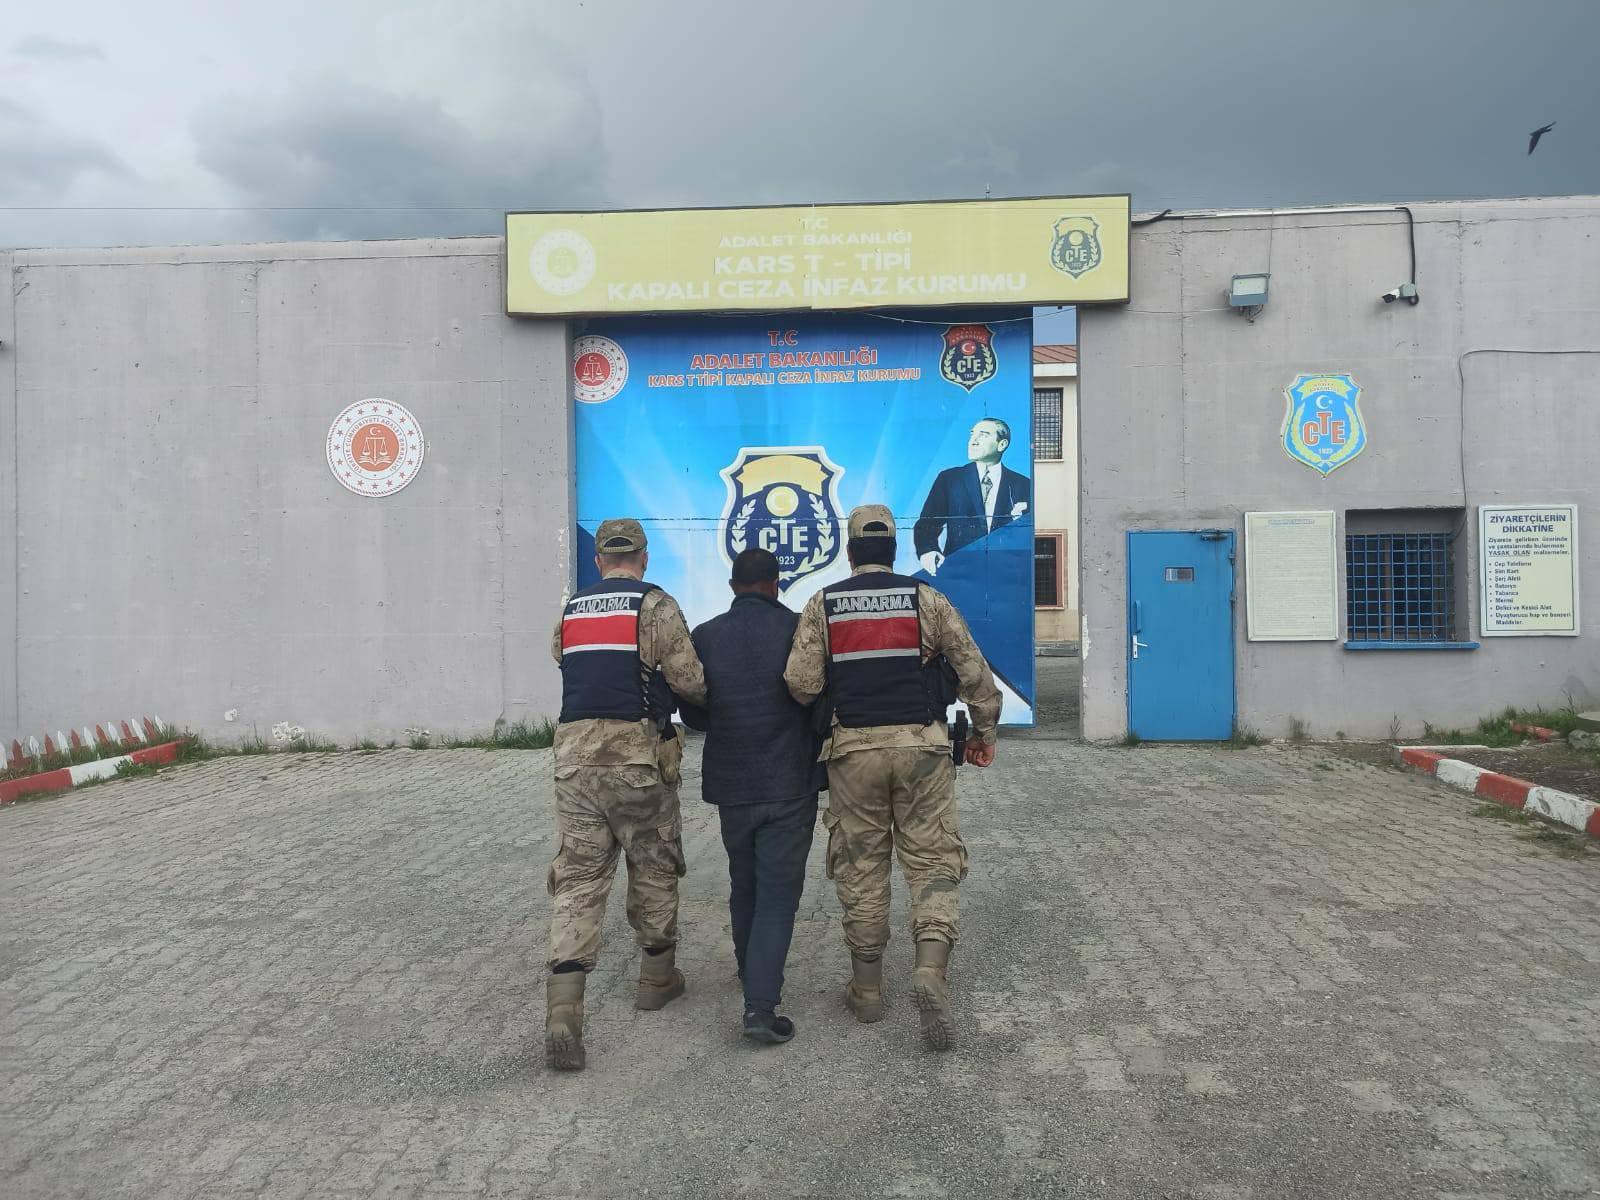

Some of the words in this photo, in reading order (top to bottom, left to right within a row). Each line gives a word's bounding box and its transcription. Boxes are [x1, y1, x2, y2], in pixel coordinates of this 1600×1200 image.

[719, 234, 795, 248] ADALET
[803, 228, 913, 246] BAKANLIĞI
[714, 254, 795, 274] KARS
[803, 254, 824, 273] T
[856, 248, 912, 272] TİPİ
[1065, 245, 1088, 262] CTE
[607, 281, 710, 301] KAPALI
[718, 279, 795, 299] CEZA
[803, 274, 889, 297] İNFAZ
[898, 272, 1027, 295] KURUMU
[767, 330, 799, 347] T.C
[690, 353, 766, 370] ADALET
[768, 345, 878, 369] BAKANLIĞI
[956, 355, 982, 373] CTE
[647, 374, 685, 388] KARS
[696, 371, 723, 387] TİPİ
[725, 372, 775, 386] KAPALI
[778, 371, 812, 385] CEZA
[814, 368, 855, 383] İNFAZ
[857, 367, 921, 382] KURUMU
[1303, 411, 1346, 447] CTE
[1489, 513, 1567, 524] ZİYARETÇİLERİN
[758, 517, 809, 554] CTE
[1502, 524, 1554, 533] DİKKATİNE
[572, 597, 631, 614] JANDARMA
[833, 595, 913, 613] JANDARMA
